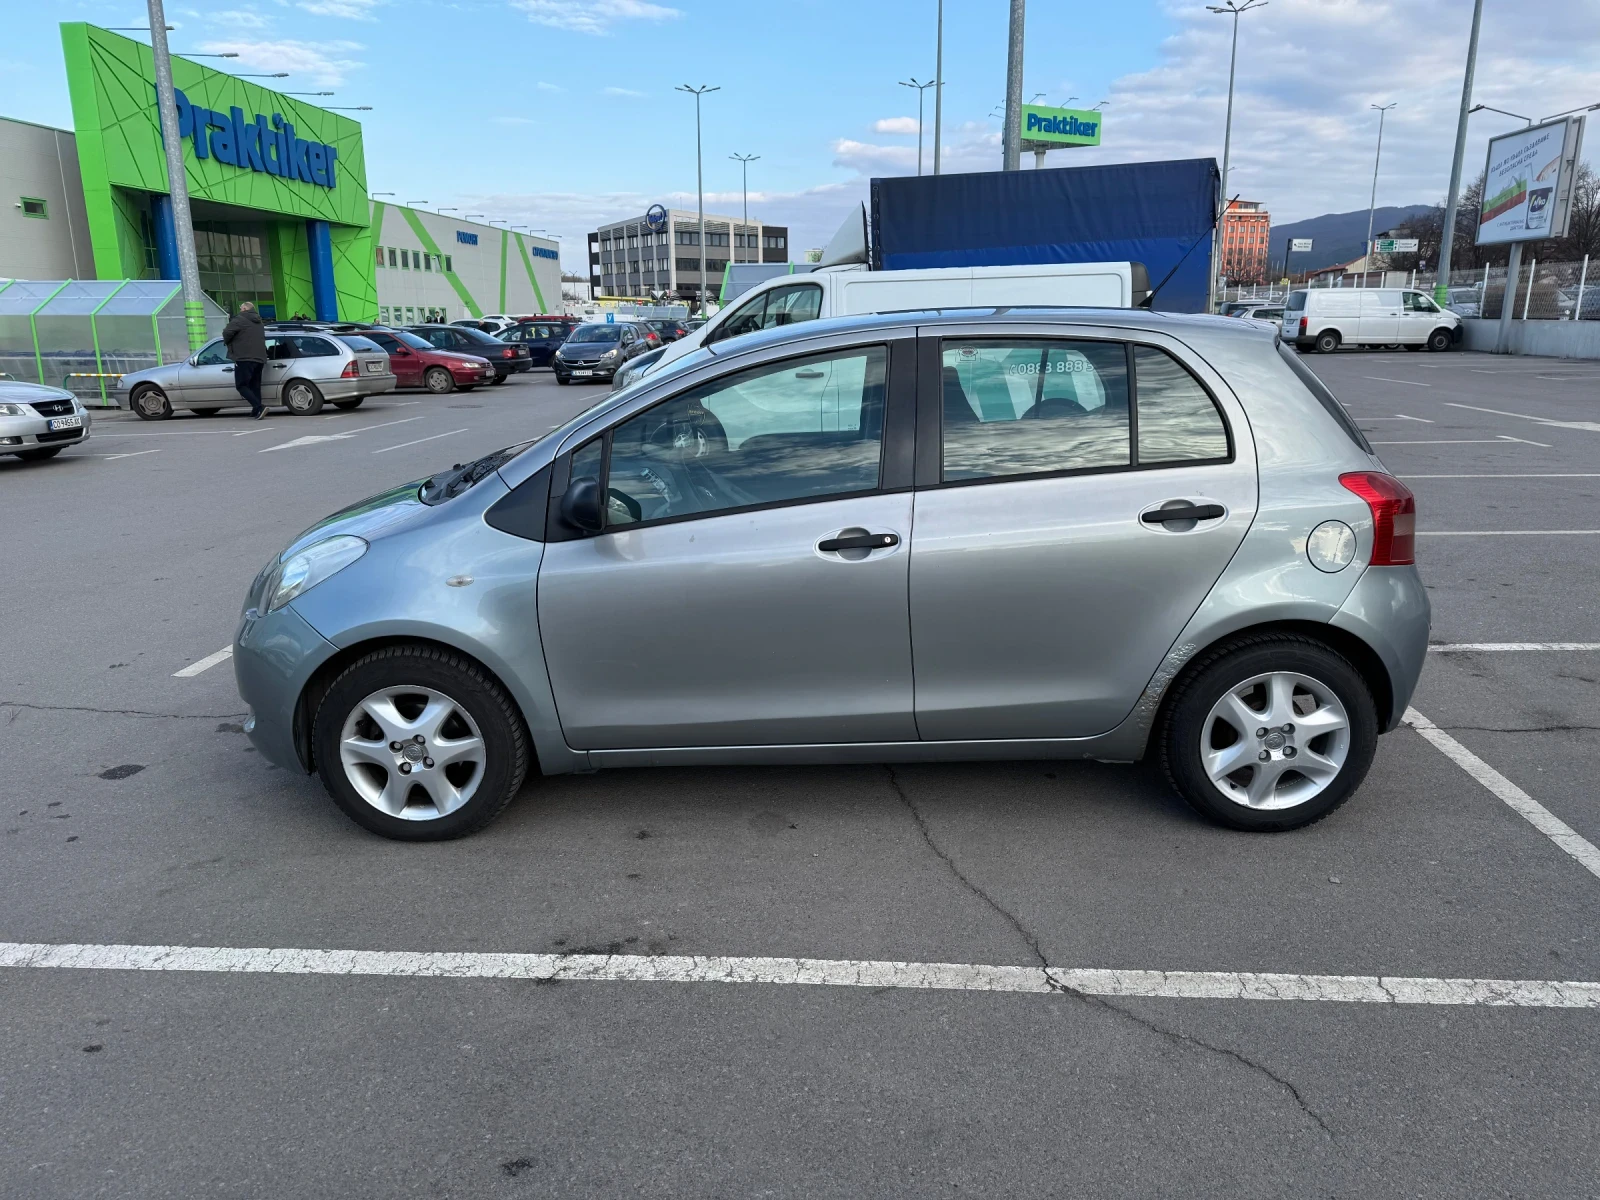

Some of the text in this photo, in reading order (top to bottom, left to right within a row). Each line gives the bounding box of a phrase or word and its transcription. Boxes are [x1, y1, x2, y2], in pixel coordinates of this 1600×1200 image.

[155, 82, 337, 188] Praktiker
[1027, 112, 1098, 137] Praktiker
[1056, 360, 1083, 373] 888
